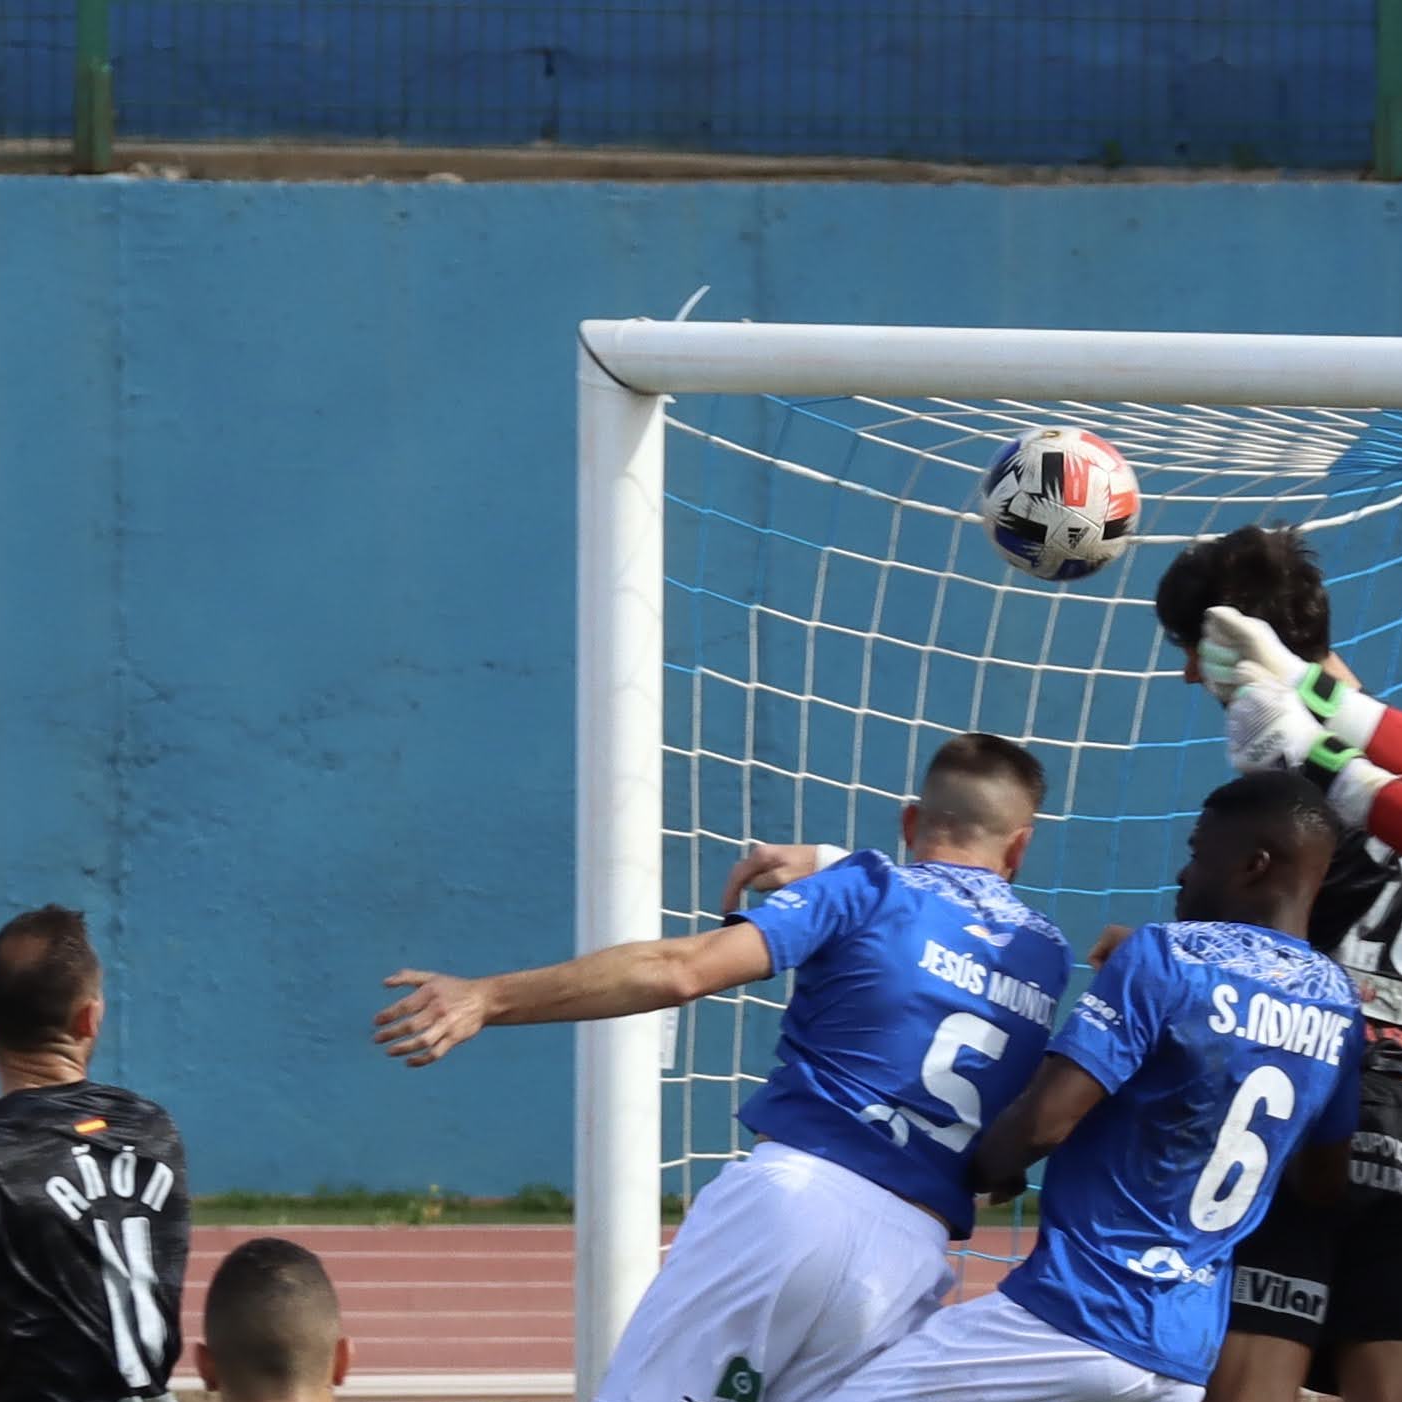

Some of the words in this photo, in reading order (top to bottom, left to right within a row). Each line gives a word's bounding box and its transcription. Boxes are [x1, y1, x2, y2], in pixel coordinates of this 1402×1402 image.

[918, 939, 988, 995] JESÚS
[901, 1011, 1011, 1153] 5
[46, 1143, 174, 1221] AÑÓN
[1189, 1065, 1295, 1232] 6
[1251, 1271, 1324, 1317] Vilar
